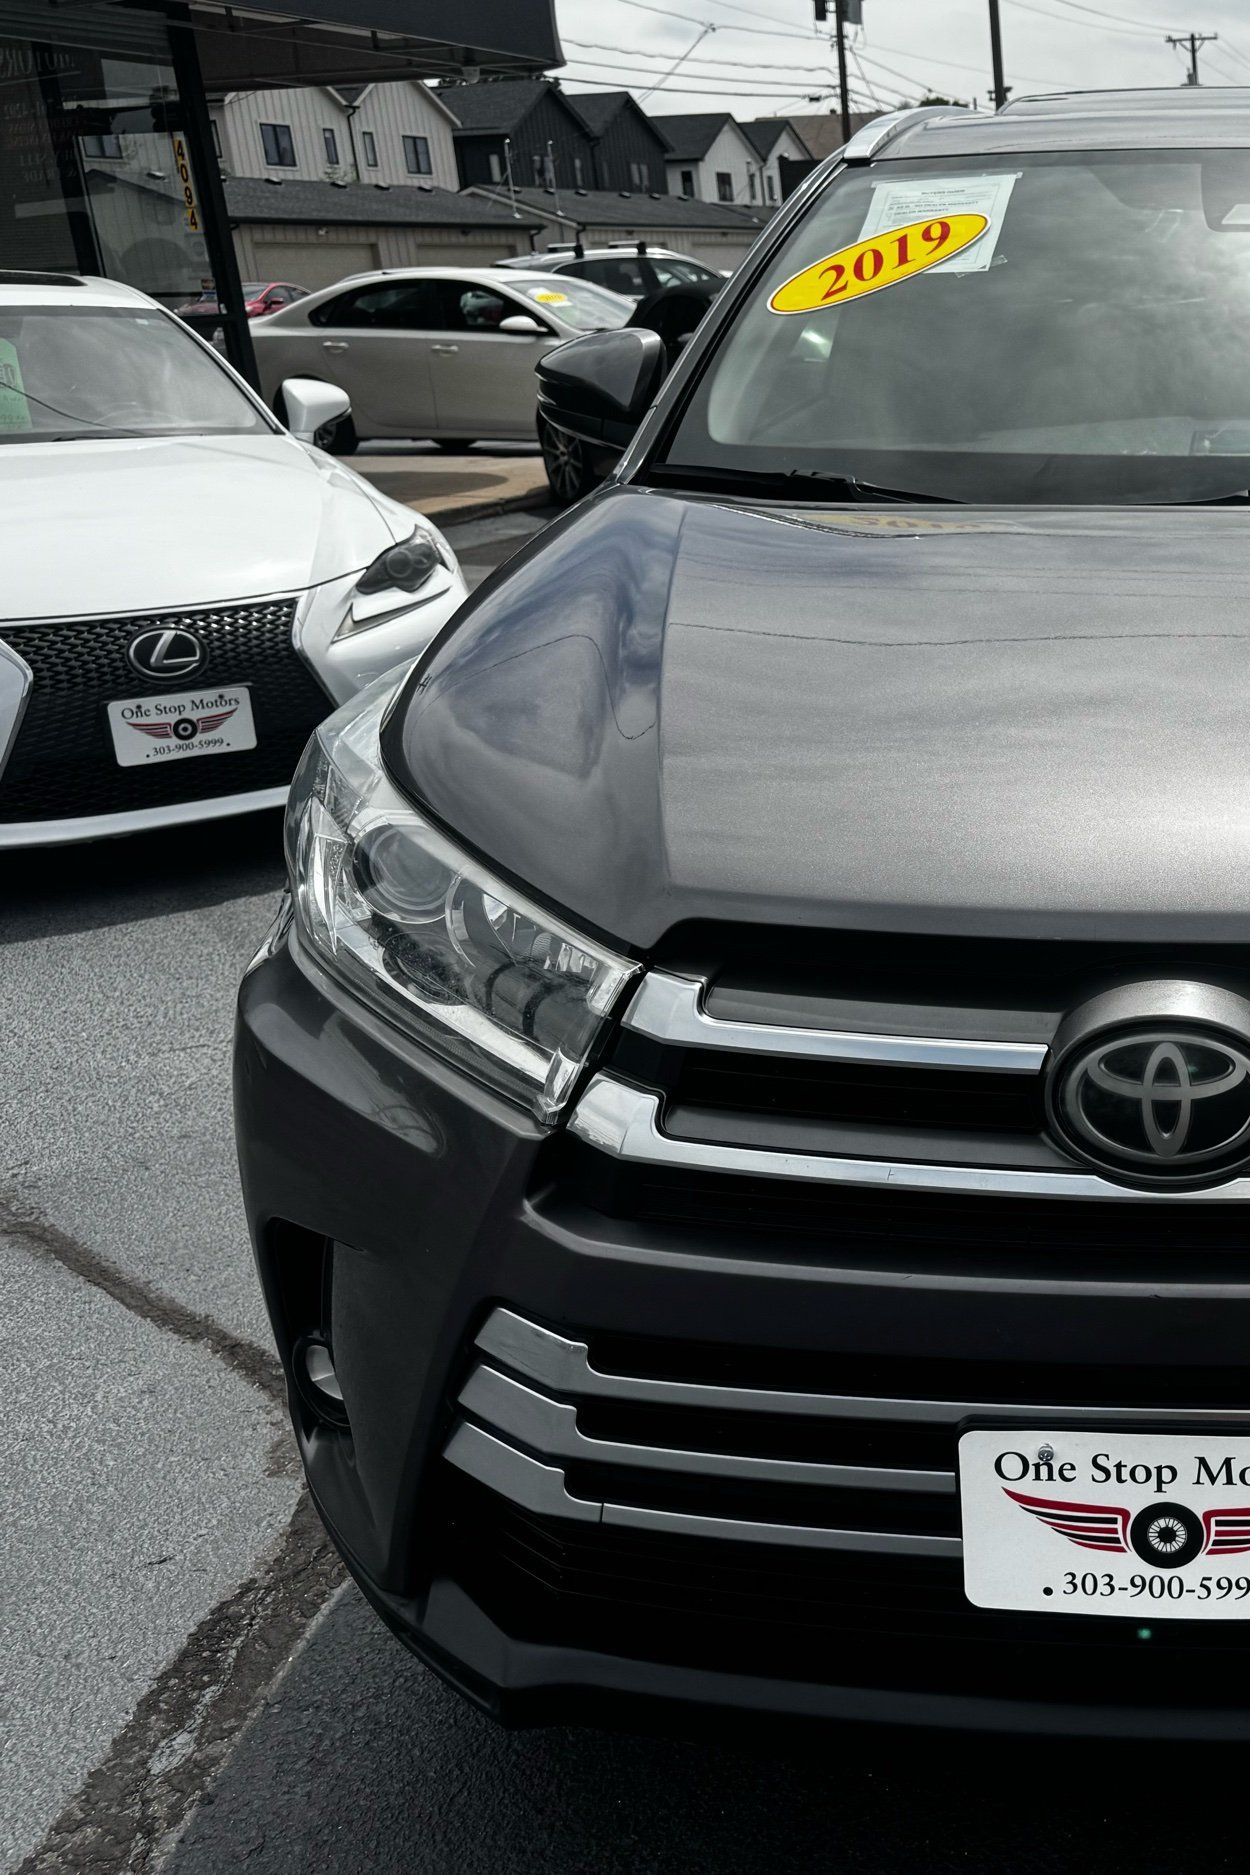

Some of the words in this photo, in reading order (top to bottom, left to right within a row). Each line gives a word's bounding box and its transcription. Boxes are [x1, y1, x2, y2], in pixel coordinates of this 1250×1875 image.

[818, 221, 951, 301] 2019
[121, 706, 151, 720] One
[155, 703, 186, 716] Stop
[191, 696, 240, 711] Motors
[153, 737, 225, 757] 303-900-5999
[994, 1450, 1077, 1482] One
[1091, 1453, 1178, 1493] Stop
